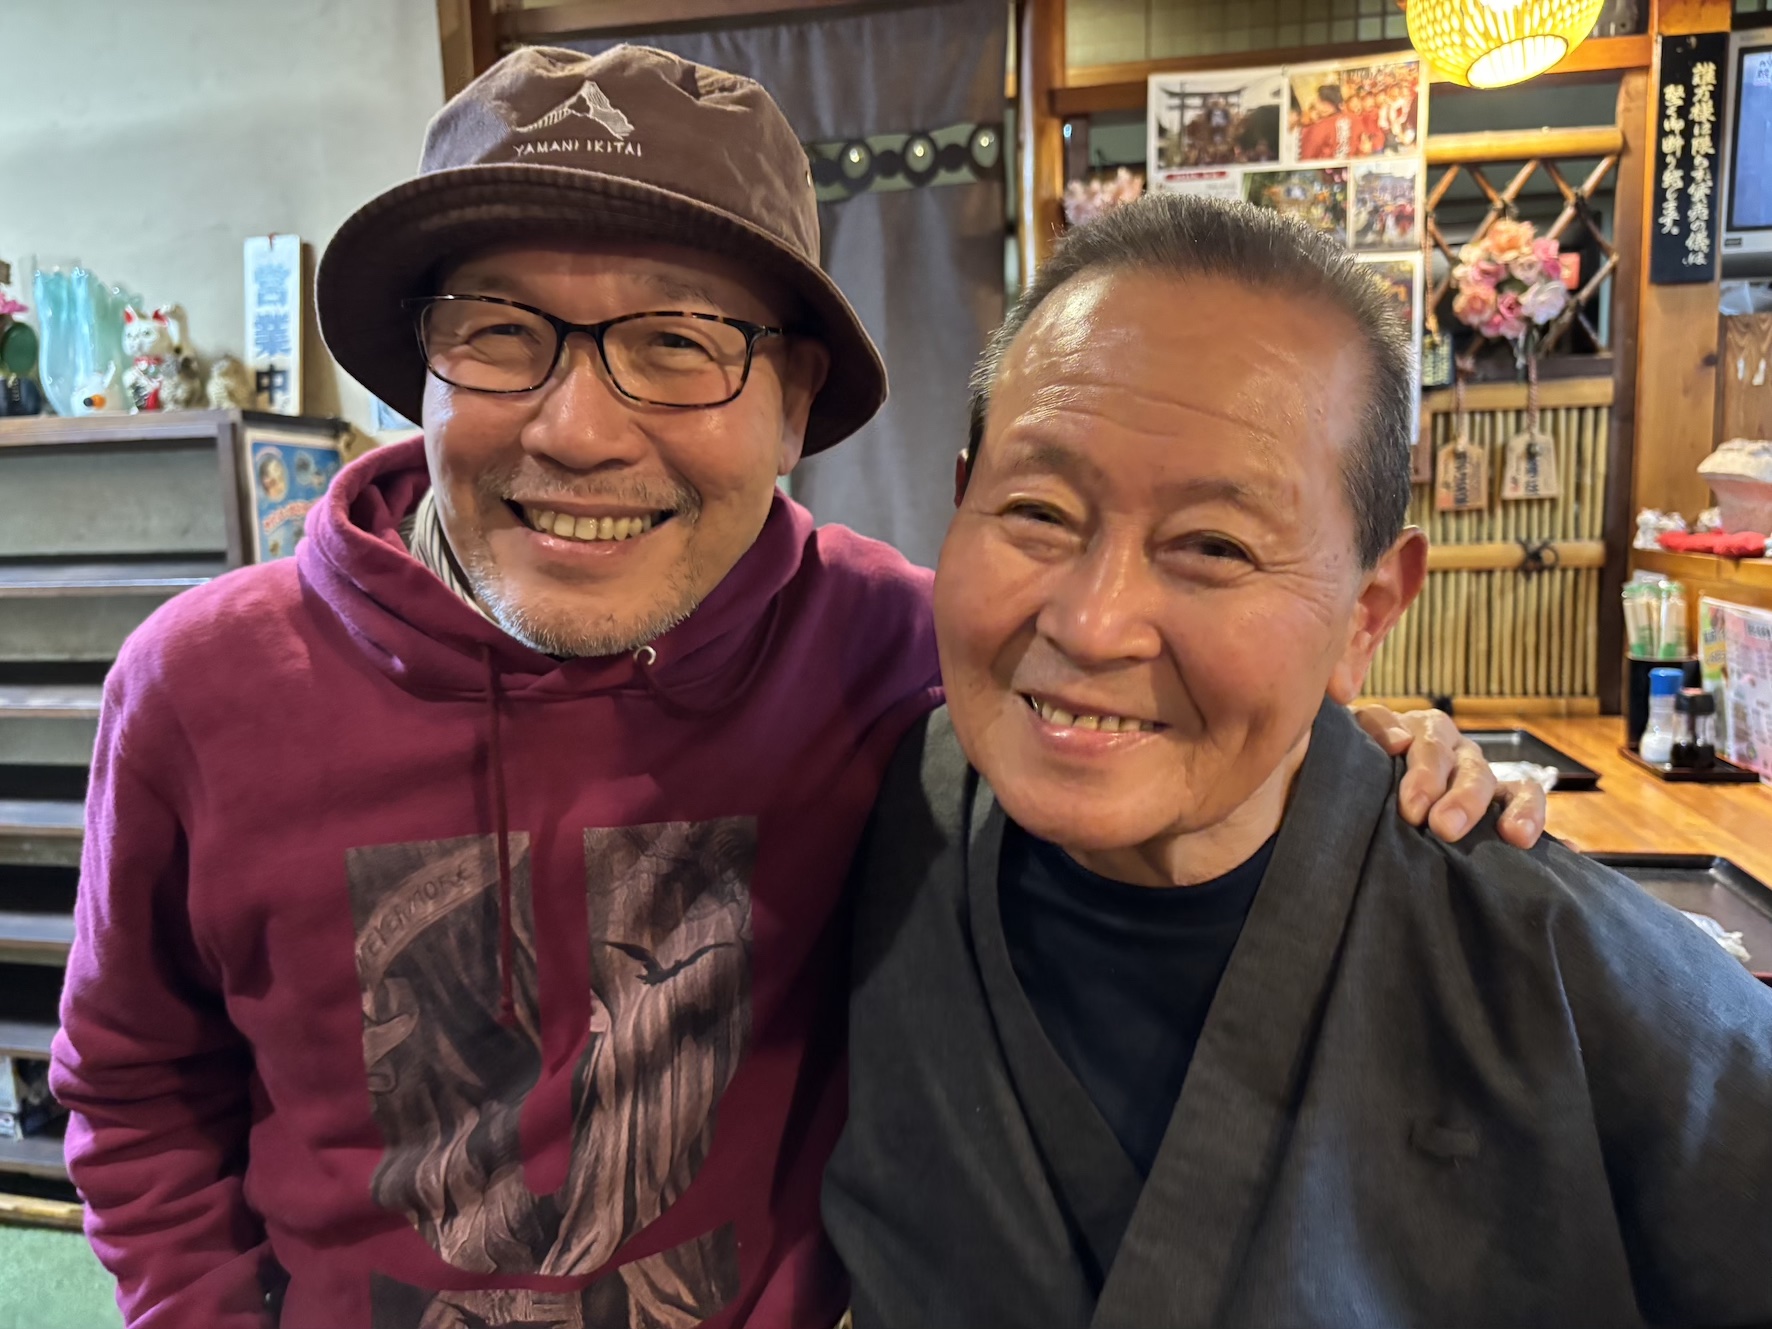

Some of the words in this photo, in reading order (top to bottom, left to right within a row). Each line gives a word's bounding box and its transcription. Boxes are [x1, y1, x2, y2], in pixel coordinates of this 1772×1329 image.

[513, 139, 579, 156] YAMANI
[587, 139, 642, 157] IKITAI
[254, 263, 291, 407] 営業中
